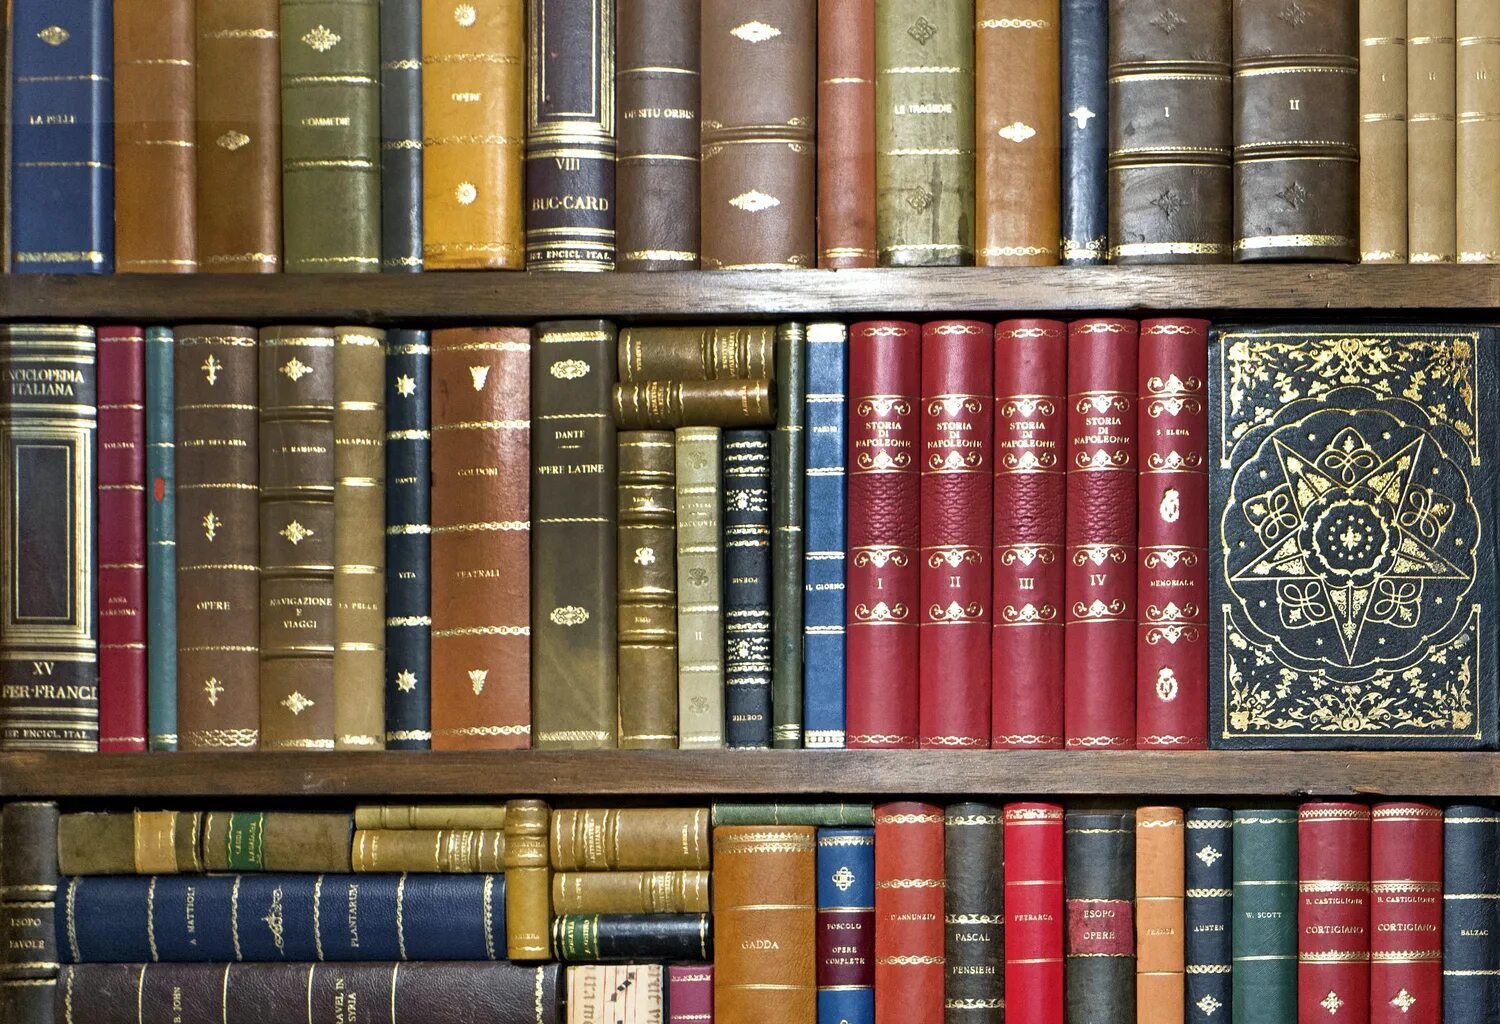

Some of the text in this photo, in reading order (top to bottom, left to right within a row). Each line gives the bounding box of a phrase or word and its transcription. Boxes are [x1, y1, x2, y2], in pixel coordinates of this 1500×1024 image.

[895, 105, 906, 115] LE
[1289, 100, 1300, 110] II
[555, 159, 581, 171] VIII
[12, 381, 74, 396] ITALIANA
[866, 421, 902, 430] STORIA
[936, 421, 972, 431] STORIA
[1010, 421, 1046, 431] STORIA
[1086, 416, 1121, 426] STORIA
[554, 430, 585, 440] DANTE
[878, 430, 890, 438] DI
[950, 430, 960, 439] DI
[1022, 430, 1033, 439] DI
[1098, 426, 1108, 434] DI
[856, 438, 911, 449] NAPOLEONE
[928, 438, 982, 449] NAPOLEONE
[1001, 438, 1056, 449] NAPOLEONE
[1074, 435, 1130, 445] NAPOLEONE
[950, 576, 960, 588] II
[1018, 578, 1034, 590] III
[1090, 574, 1106, 586] IV
[284, 620, 317, 630] VIAGGI
[33, 662, 54, 676] XV
[350, 885, 359, 948] PLANTARUM
[1014, 914, 1053, 922] PETRARCA
[1084, 909, 1116, 919] ESOPO
[826, 922, 862, 931] FOSCOLO
[1194, 924, 1225, 932] AUSTEN
[956, 932, 991, 942] PASCAL
[1083, 931, 1116, 940] OPERE
[1460, 928, 1489, 936] BALZAC
[741, 940, 779, 950] GADDA
[832, 946, 858, 955] OPERE
[953, 964, 996, 976] PENSIERI
[336, 978, 344, 990] IN
[173, 986, 182, 1024] B. JOHN
[348, 992, 356, 1023] SYRIA
